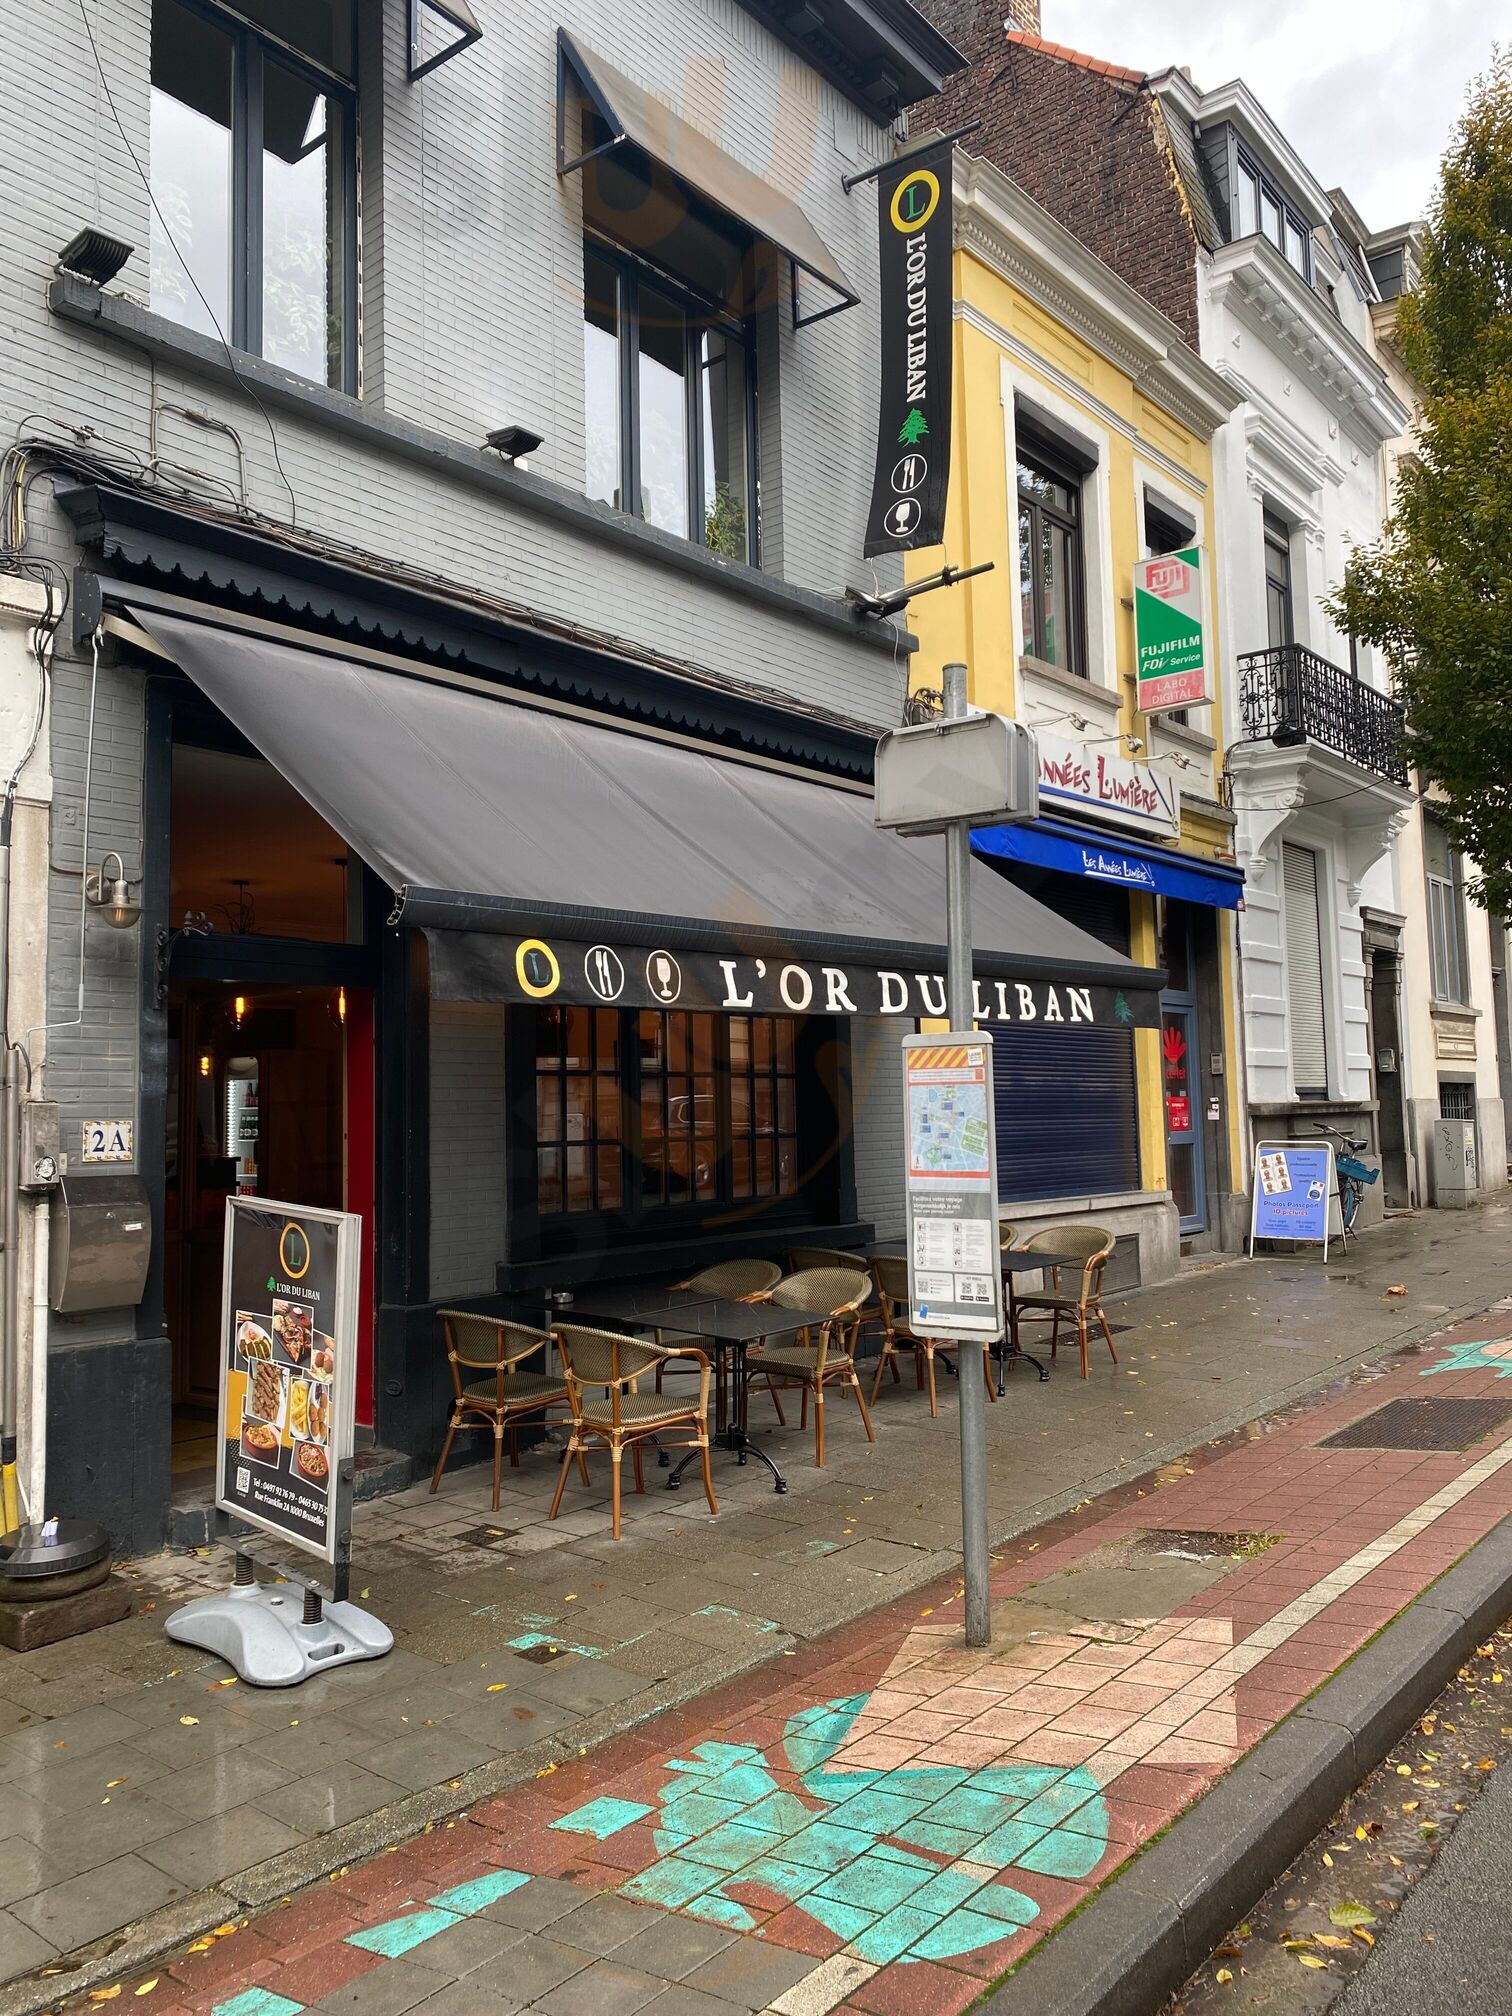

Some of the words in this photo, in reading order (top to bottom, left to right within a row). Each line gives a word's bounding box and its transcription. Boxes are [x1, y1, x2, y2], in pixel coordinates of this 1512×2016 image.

[906, 232, 927, 291] L'OR
[906, 287, 927, 326] DU
[906, 327, 927, 402] LIBAN
[1140, 635, 1201, 658] FUJIFILM
[1169, 653, 1201, 666] Service
[1156, 678, 1187, 692] LABO
[1151, 689, 1193, 705] DIGITAL
[718, 958, 857, 1011] L'OR
[877, 971, 949, 1015] DU
[971, 980, 1095, 1022] LIBAN
[92, 1129, 127, 1152] 2A
[276, 1282, 291, 1295] L'OR
[291, 1286, 301, 1297] DU
[302, 1288, 320, 1301] LIBAN
[253, 1477, 261, 1488] Tel
[262, 1481, 275, 1493] 0497
[254, 1490, 264, 1501] Rue
[263, 1494, 283, 1509] Franklin
[289, 1505, 302, 1517] 1000
[301, 1510, 325, 1527] Bruxelles
